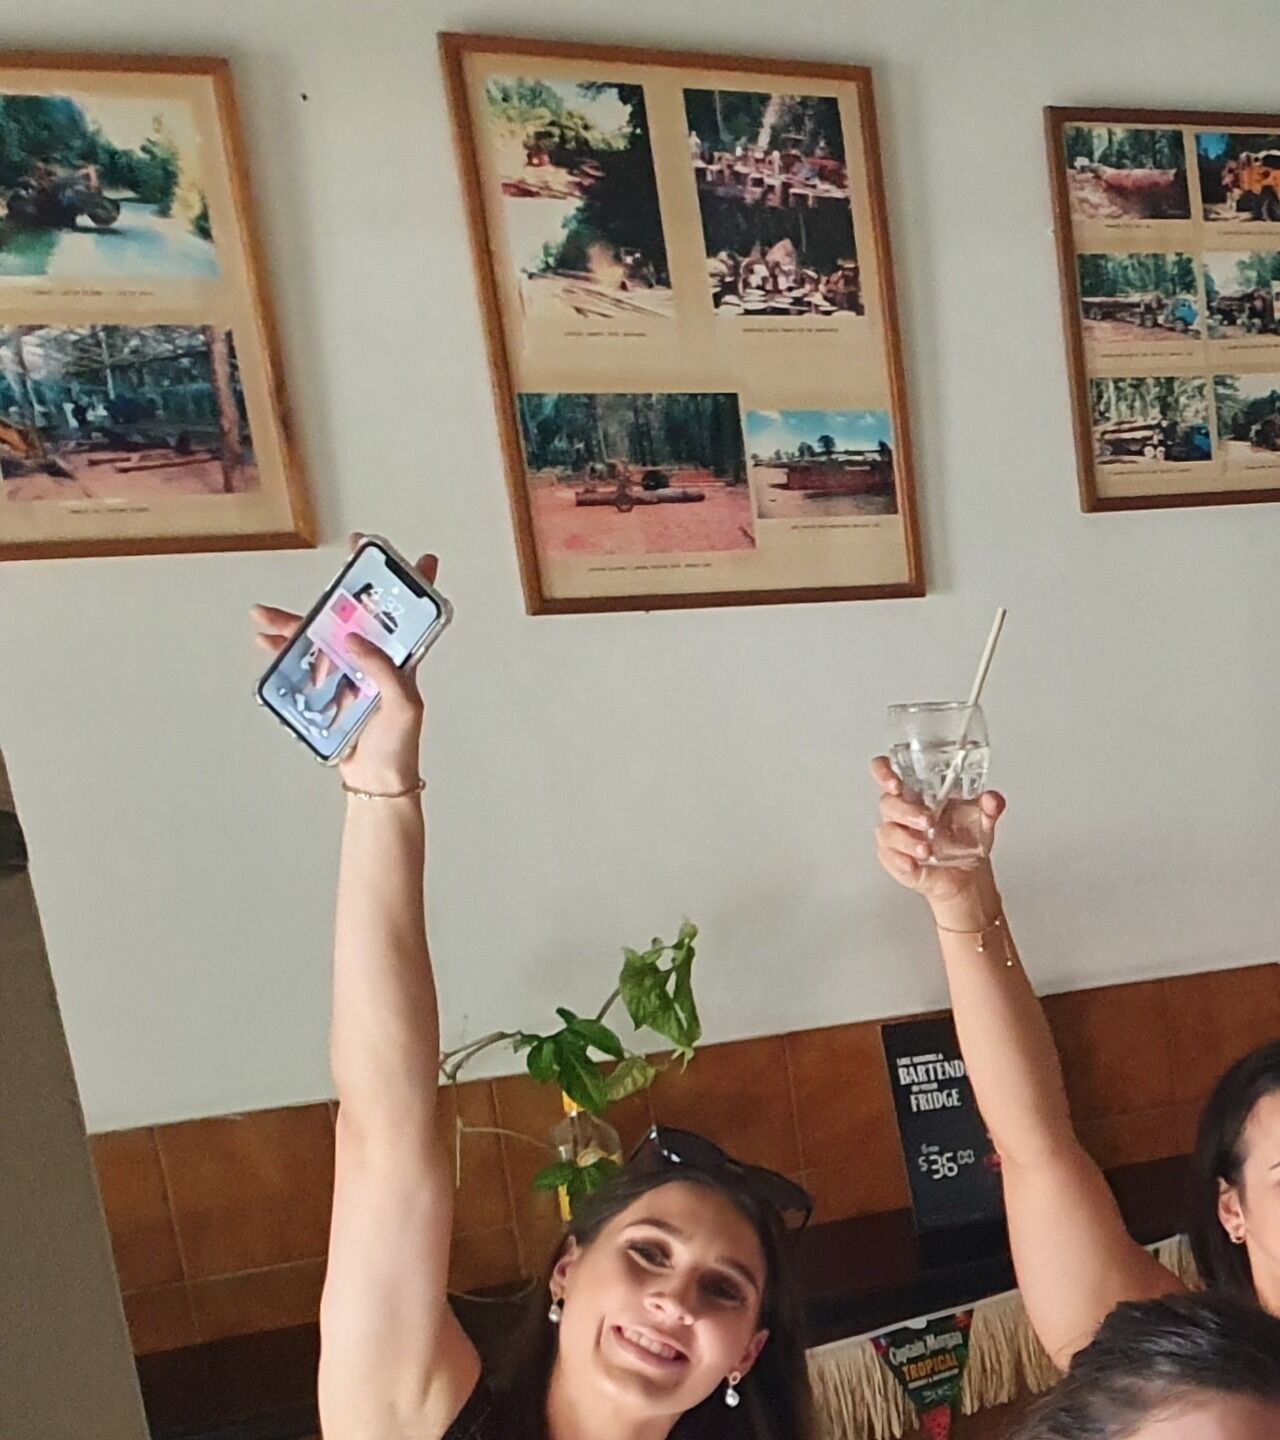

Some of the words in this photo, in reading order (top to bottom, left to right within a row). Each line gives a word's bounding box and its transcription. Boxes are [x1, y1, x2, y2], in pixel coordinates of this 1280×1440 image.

[898, 1059, 968, 1086] BARTEND
[910, 1088, 962, 1113] FRIDGE
[902, 1352, 960, 1382] TROPICAL
